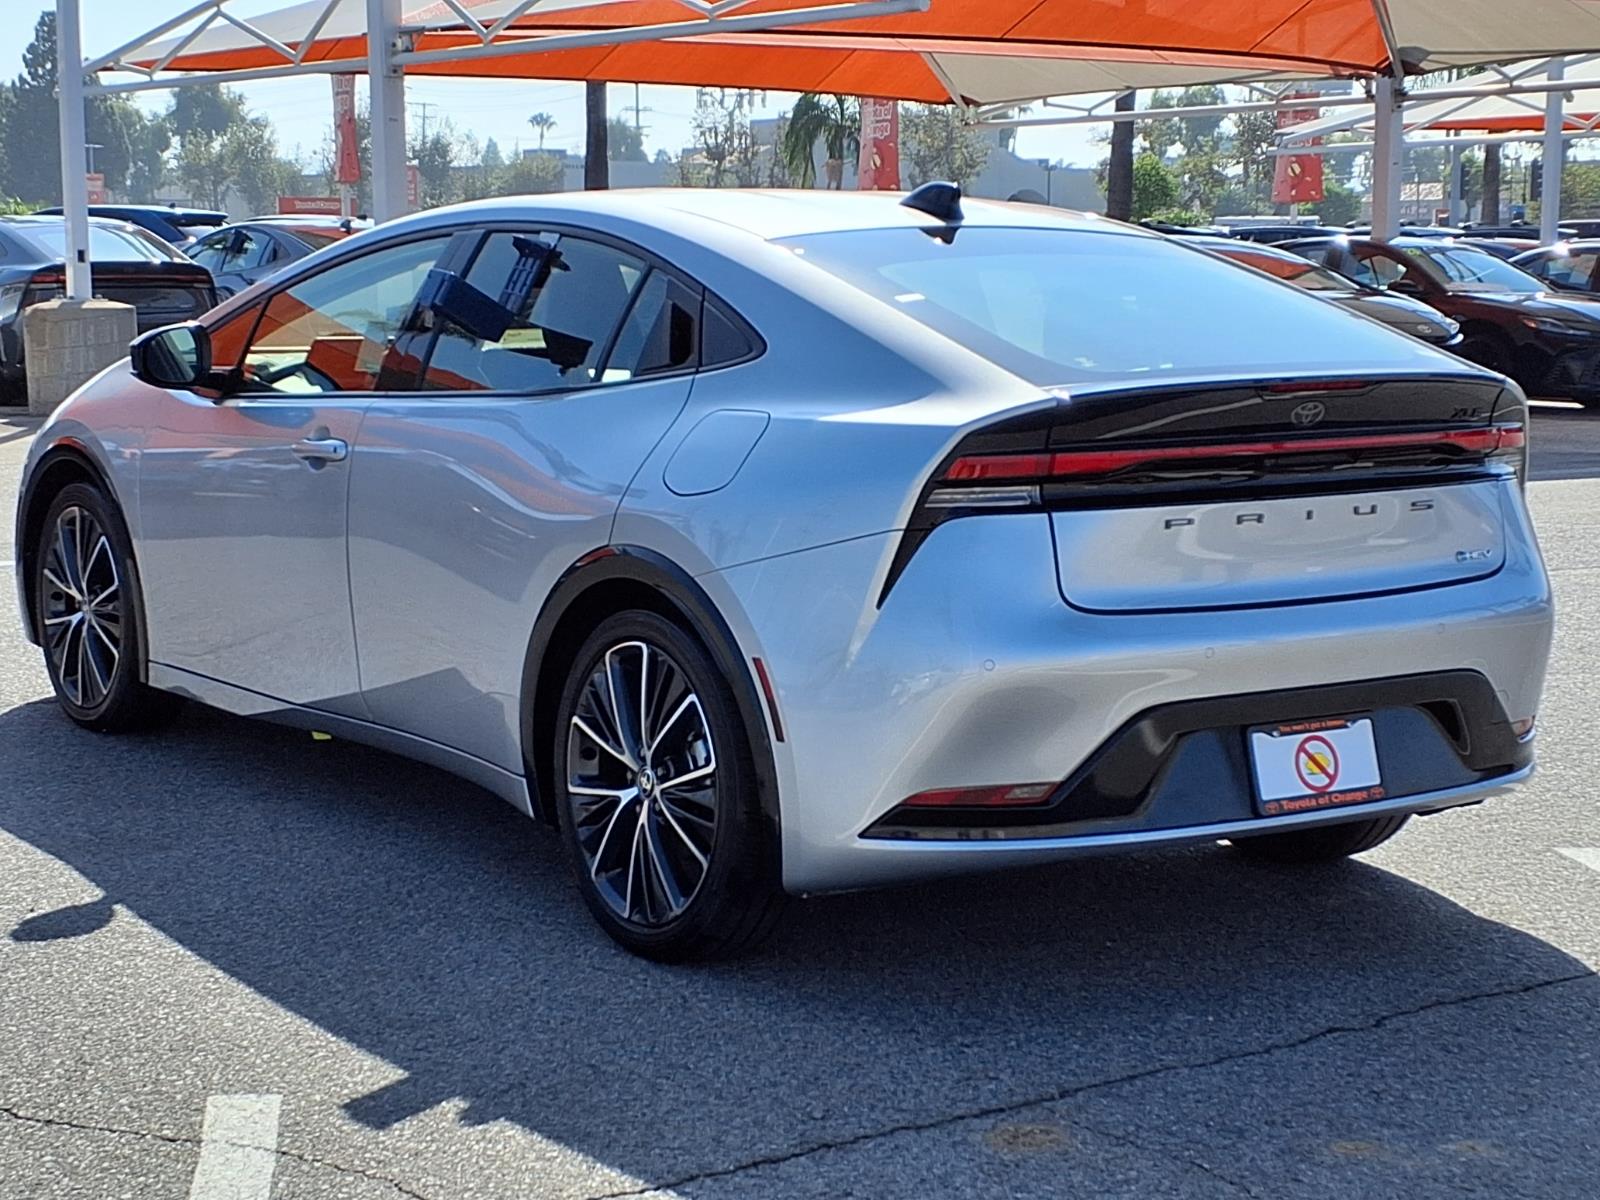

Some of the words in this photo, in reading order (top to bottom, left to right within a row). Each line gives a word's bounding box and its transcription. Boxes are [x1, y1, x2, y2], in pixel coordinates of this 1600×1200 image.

[1164, 499, 1435, 530] PRIUS
[1281, 797, 1317, 810] Toyota
[1318, 794, 1329, 805] of
[1331, 790, 1368, 804] Orange
